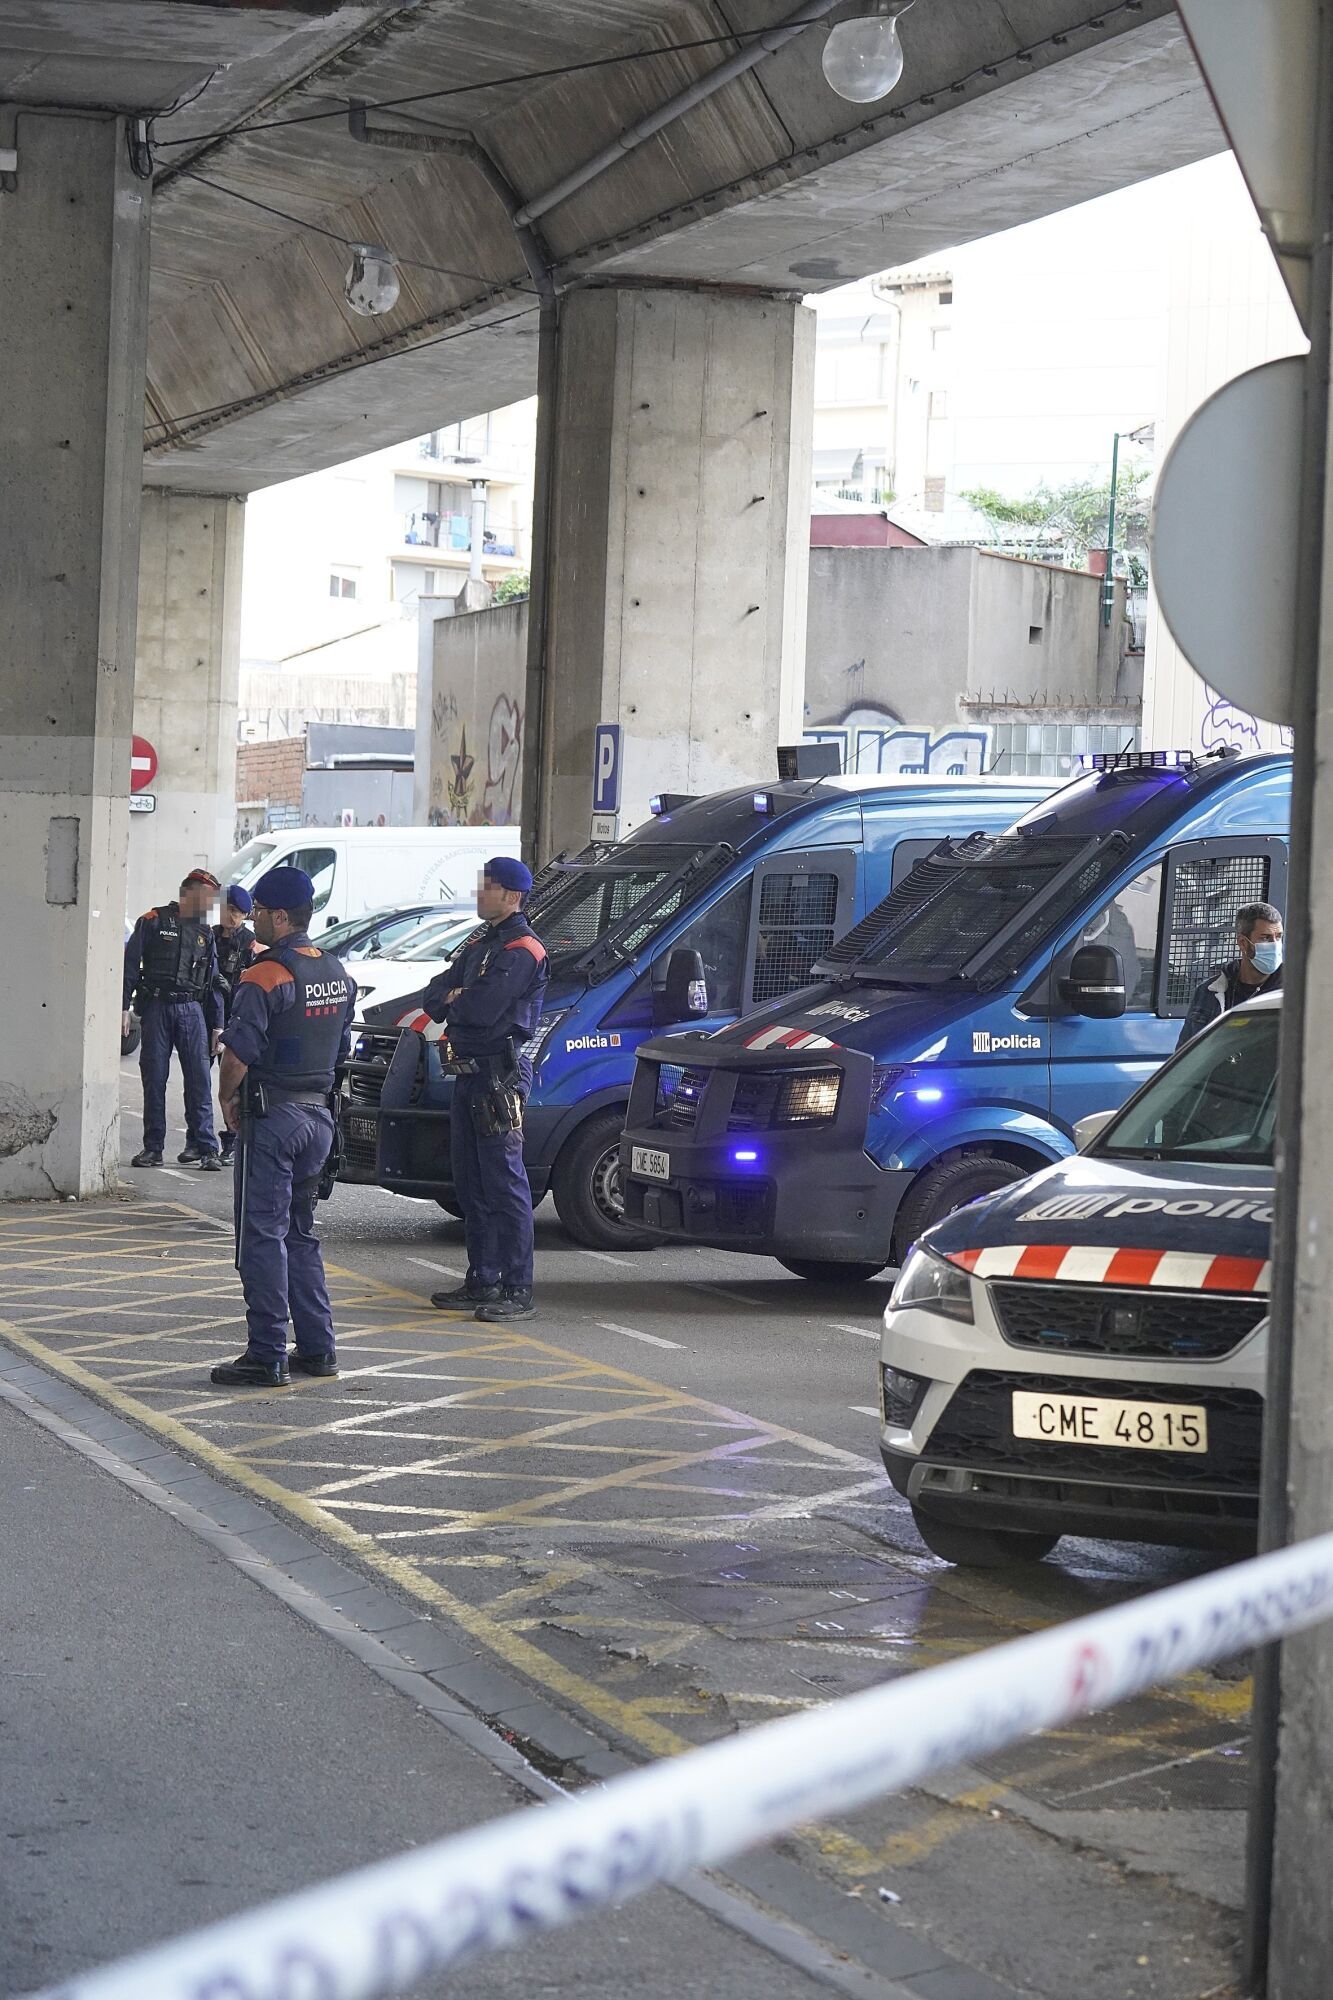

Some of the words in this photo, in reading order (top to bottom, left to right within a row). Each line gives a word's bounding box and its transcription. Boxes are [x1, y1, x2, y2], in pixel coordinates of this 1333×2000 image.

[598, 733, 614, 802] P
[304, 979, 348, 999] POLICIA
[566, 1034, 608, 1053] policia
[991, 1034, 1041, 1052] policia
[1103, 1198, 1276, 1223] polic
[1039, 1403, 1100, 1440] CME
[1114, 1409, 1200, 1447] 4815
